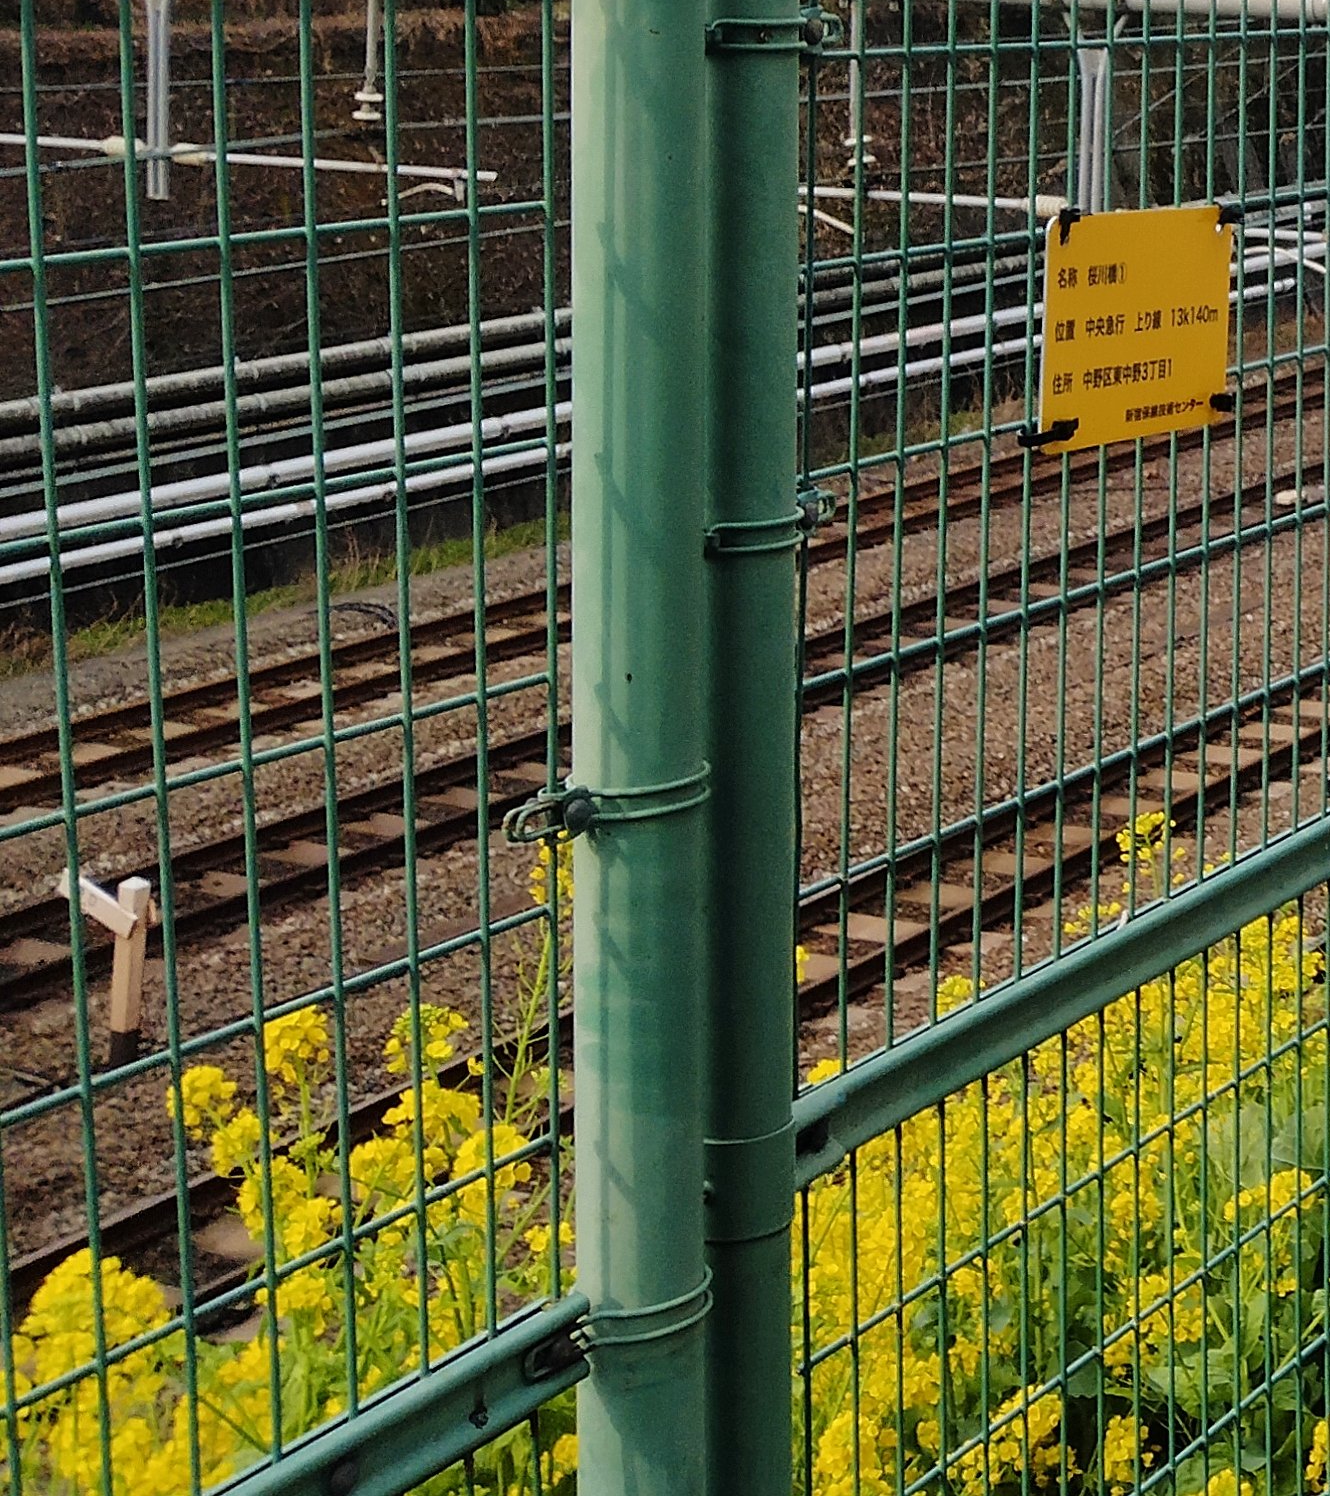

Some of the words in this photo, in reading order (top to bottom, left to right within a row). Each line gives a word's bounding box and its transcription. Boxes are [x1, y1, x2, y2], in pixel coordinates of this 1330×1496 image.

[1057, 267, 1078, 289] 名称
[1055, 319, 1076, 343] 位置
[1085, 313, 1125, 339] 中央急行
[1134, 308, 1162, 333] 上り線
[1171, 304, 1219, 327] 13k140m
[1052, 370, 1074, 396] 住所
[1082, 358, 1173, 392] 中野区東中野3丁目1
